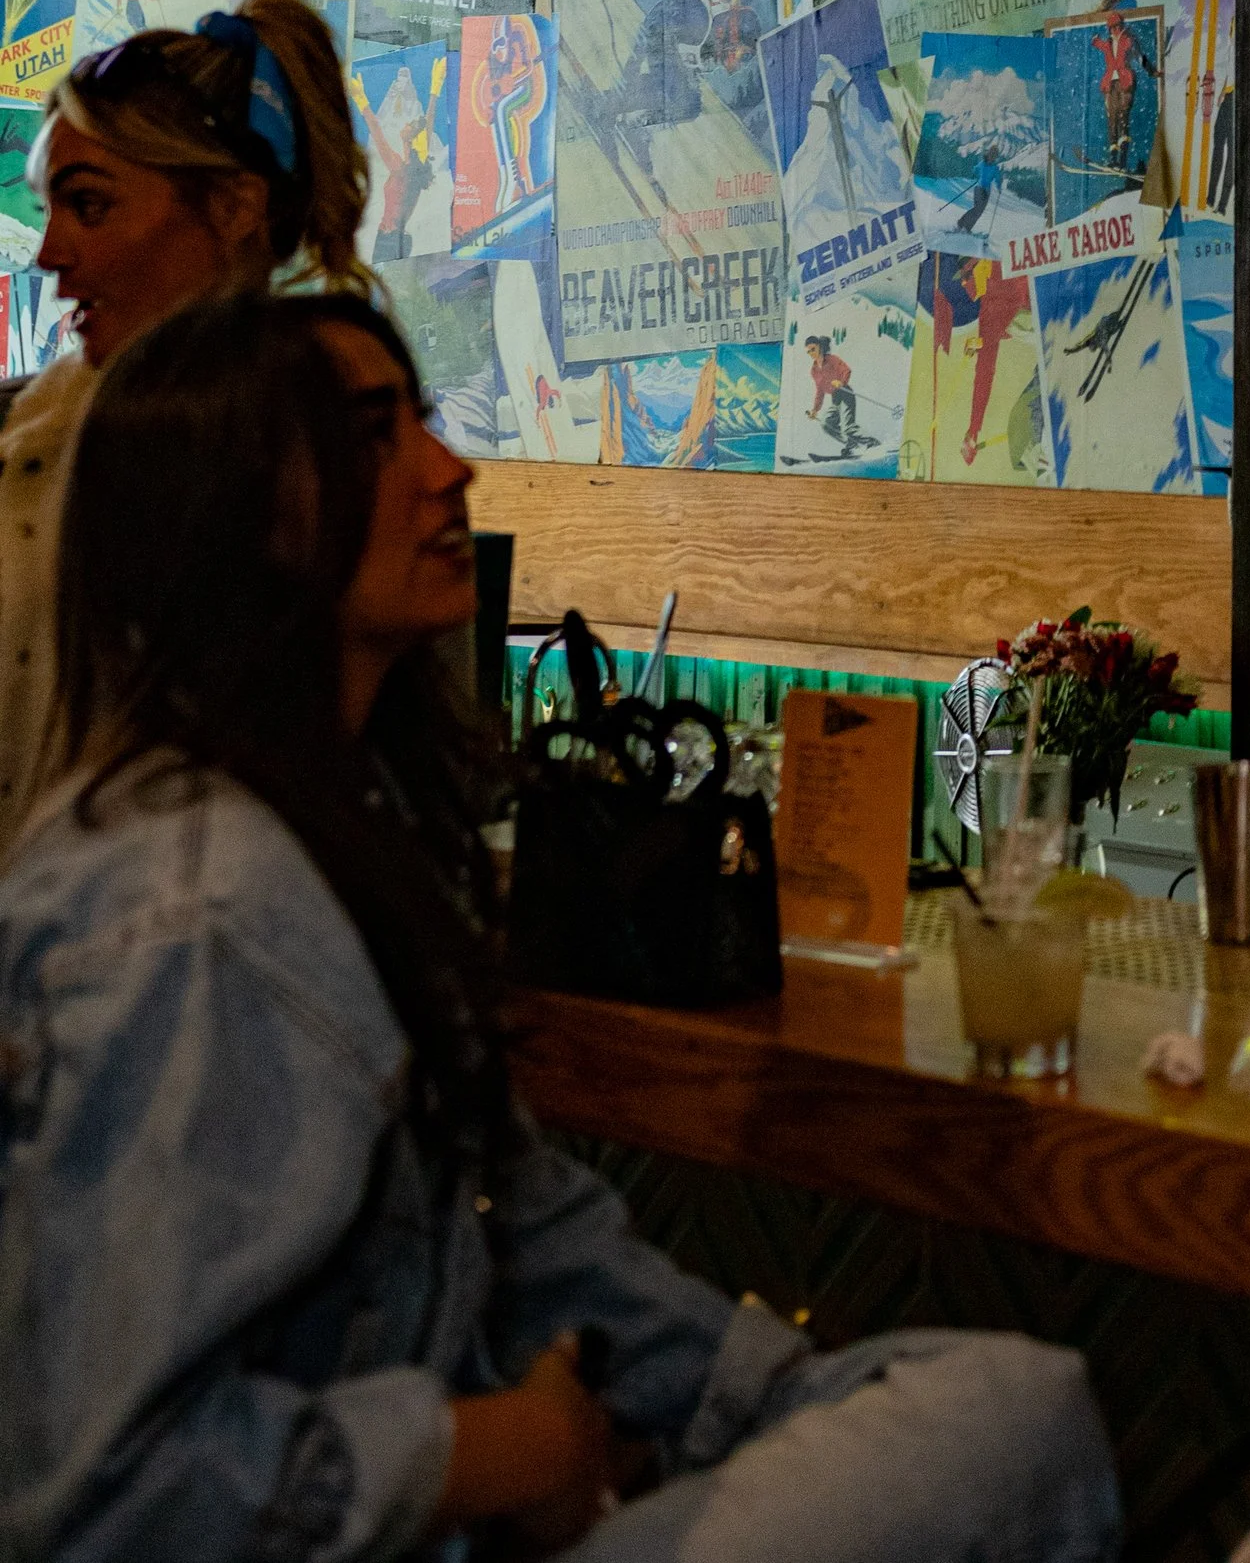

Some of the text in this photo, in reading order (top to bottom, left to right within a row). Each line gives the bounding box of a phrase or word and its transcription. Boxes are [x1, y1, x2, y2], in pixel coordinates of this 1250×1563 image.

[40, 19, 73, 46] CITY
[15, 43, 66, 80] UTAH
[727, 200, 779, 228] DOWNHILL
[796, 199, 917, 285] ZERMATT
[1008, 213, 1136, 272] LAKE TAHOE
[562, 245, 781, 338] BEAVER CREEK
[804, 282, 836, 307] SCHWEIZ
[839, 256, 893, 289] SWITZERLAND
